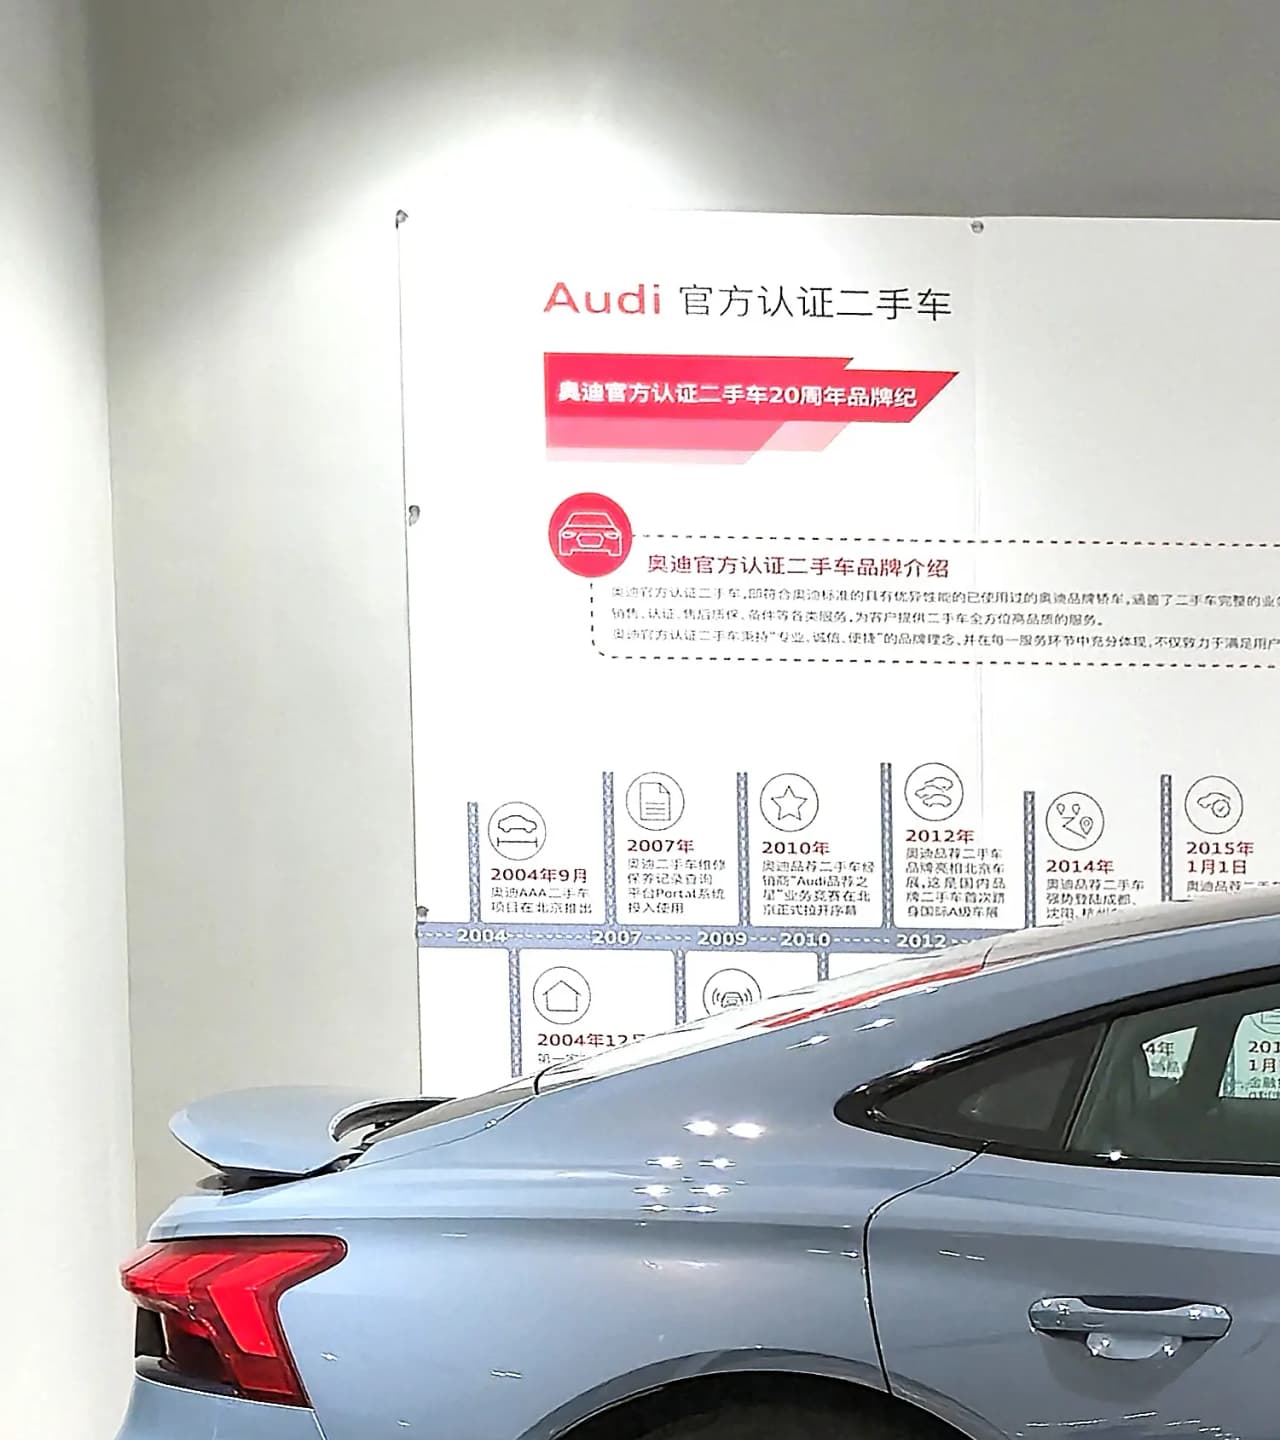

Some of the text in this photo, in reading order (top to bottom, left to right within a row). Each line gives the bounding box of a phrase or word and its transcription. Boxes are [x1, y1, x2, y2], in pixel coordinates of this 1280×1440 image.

[543, 280, 952, 321] Audi 官方认证二手车
[557, 380, 919, 410] 奥迪官方认证二手车20周年品牌纪
[648, 554, 950, 579] 奥迪官方认证二手车品牌介绍
[905, 829, 974, 844] 2012年
[627, 839, 695, 854] 2007年
[762, 841, 830, 856] 2010年
[1186, 841, 1254, 857] 2015年
[1046, 859, 1115, 875] 2014年
[1187, 859, 1247, 875] 1月1日
[490, 868, 588, 884] 2004年9月
[627, 902, 685, 915] 投入使用
[457, 929, 947, 949] 2004 2007 2009 2010 2012
